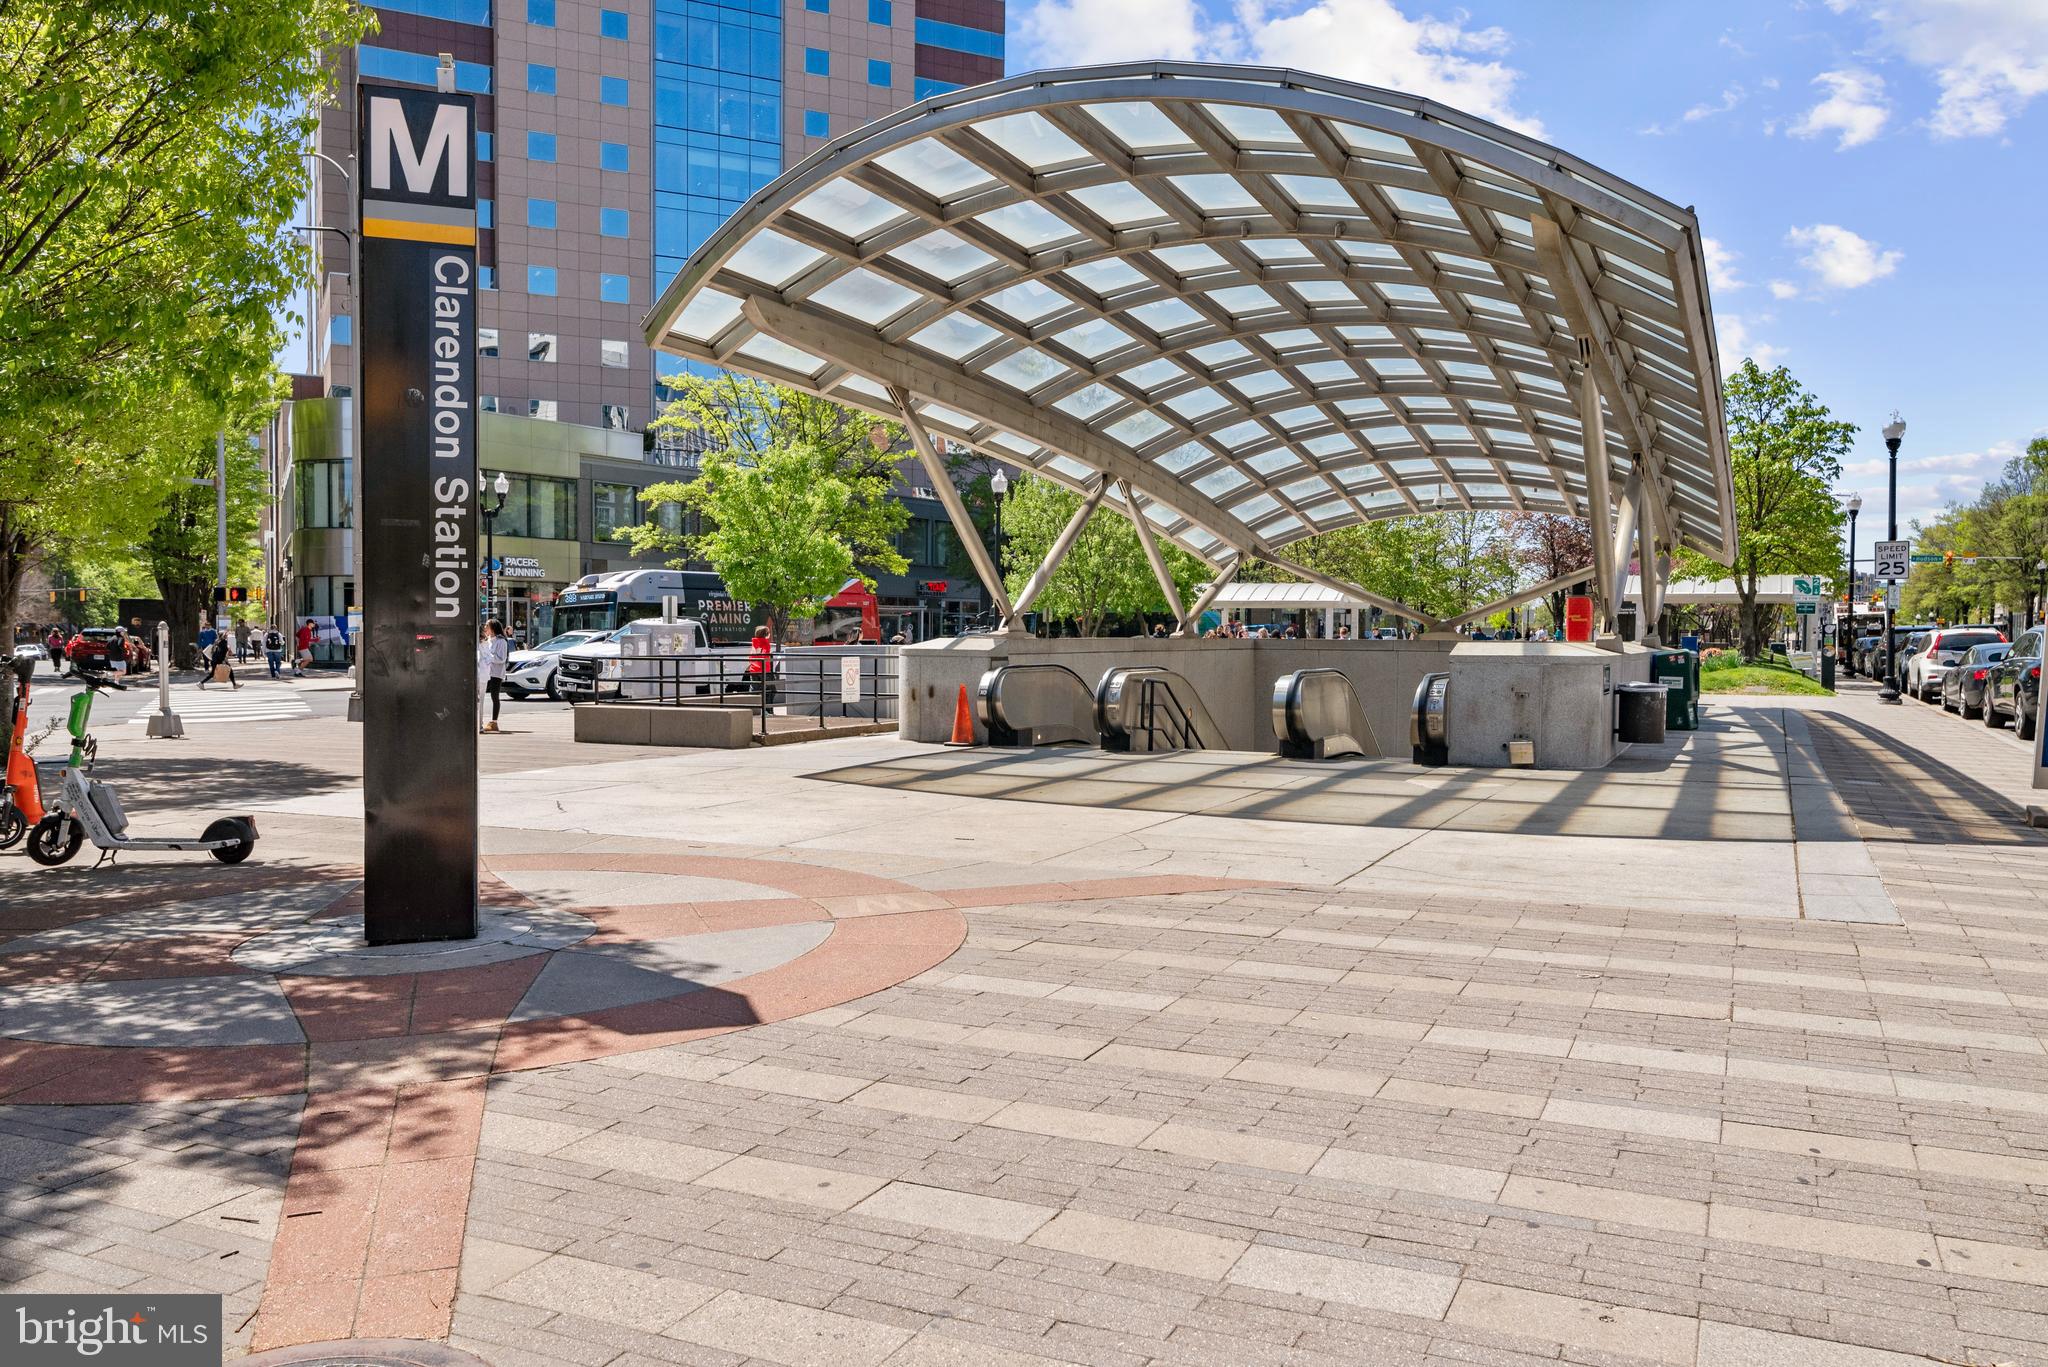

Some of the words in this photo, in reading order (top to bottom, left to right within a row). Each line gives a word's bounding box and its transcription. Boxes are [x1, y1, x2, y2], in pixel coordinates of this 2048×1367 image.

[370, 95, 468, 197] M
[434, 255, 470, 458] Clarendon
[434, 476, 469, 618] Station
[505, 557, 539, 567] PACERS
[1878, 561, 1905, 576] 25
[505, 568, 546, 578] RUNNING
[697, 599, 752, 612] PREMIER
[700, 612, 751, 625] GAMING
